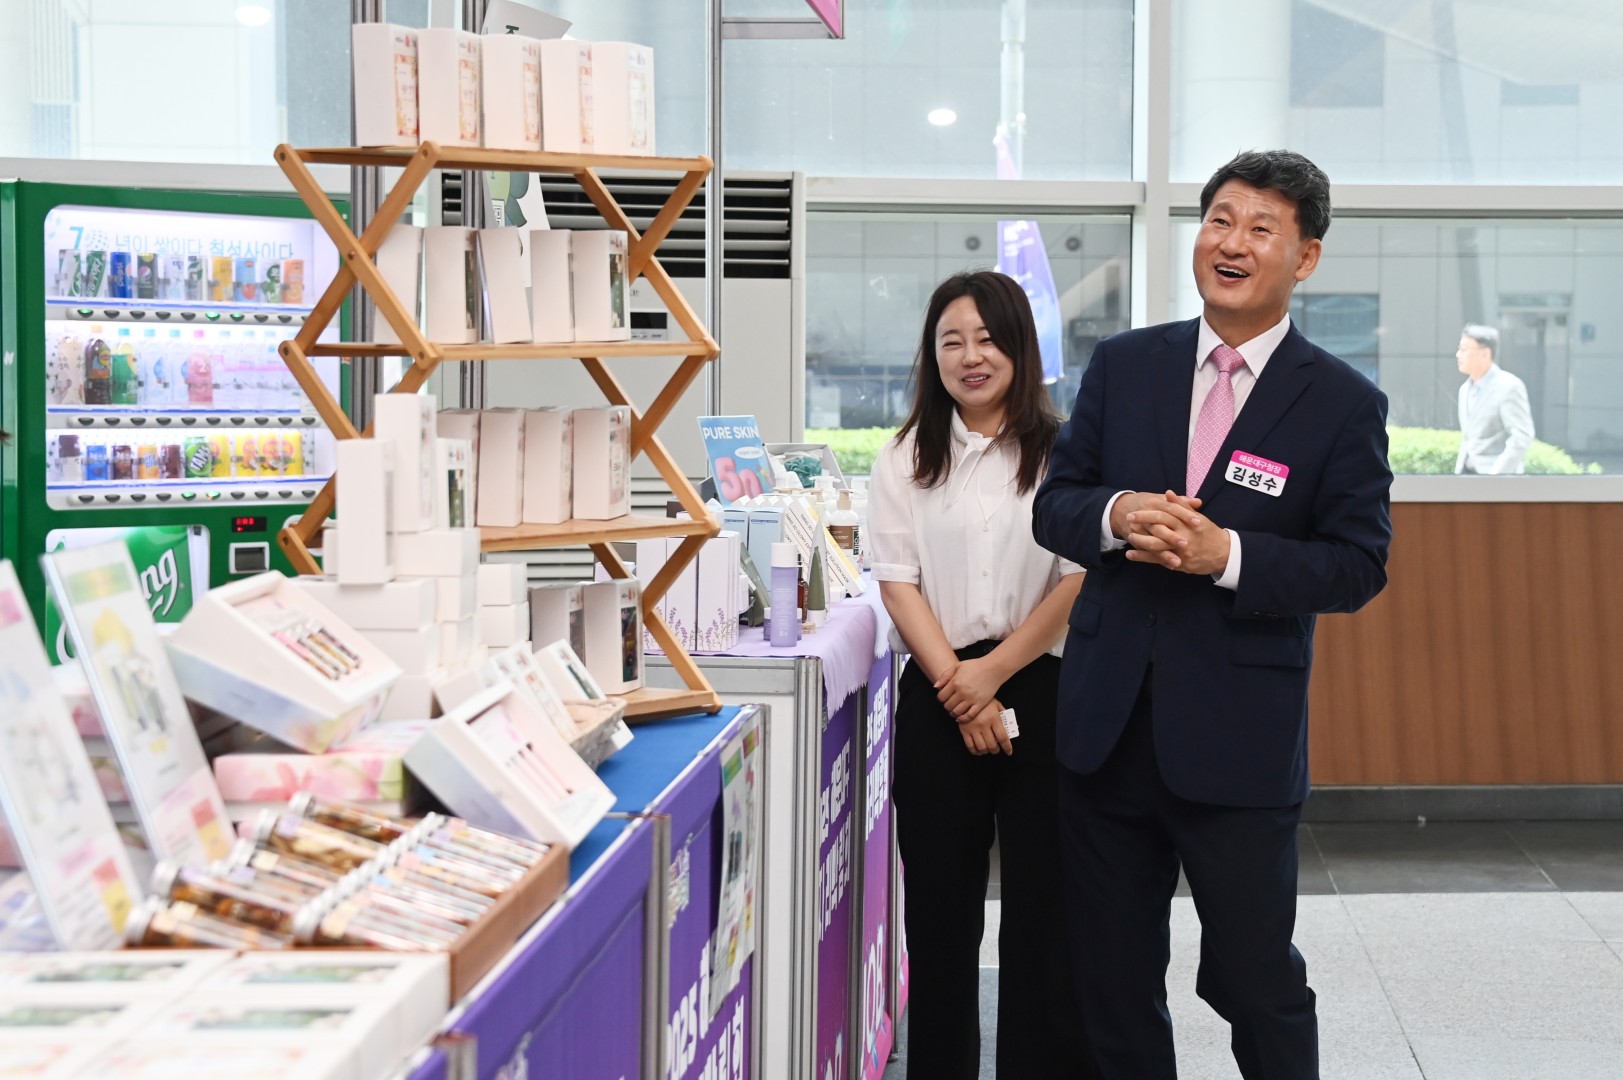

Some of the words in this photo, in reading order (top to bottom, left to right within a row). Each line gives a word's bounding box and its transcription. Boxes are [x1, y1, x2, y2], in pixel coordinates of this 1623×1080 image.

[703, 426, 733, 440] PURE
[733, 426, 760, 439] SKIN
[1239, 454, 1282, 474] 해운대구청장
[1233, 466, 1277, 491] 김성수
[829, 556, 842, 573] SOLUTION
[841, 573, 849, 582] MASK
